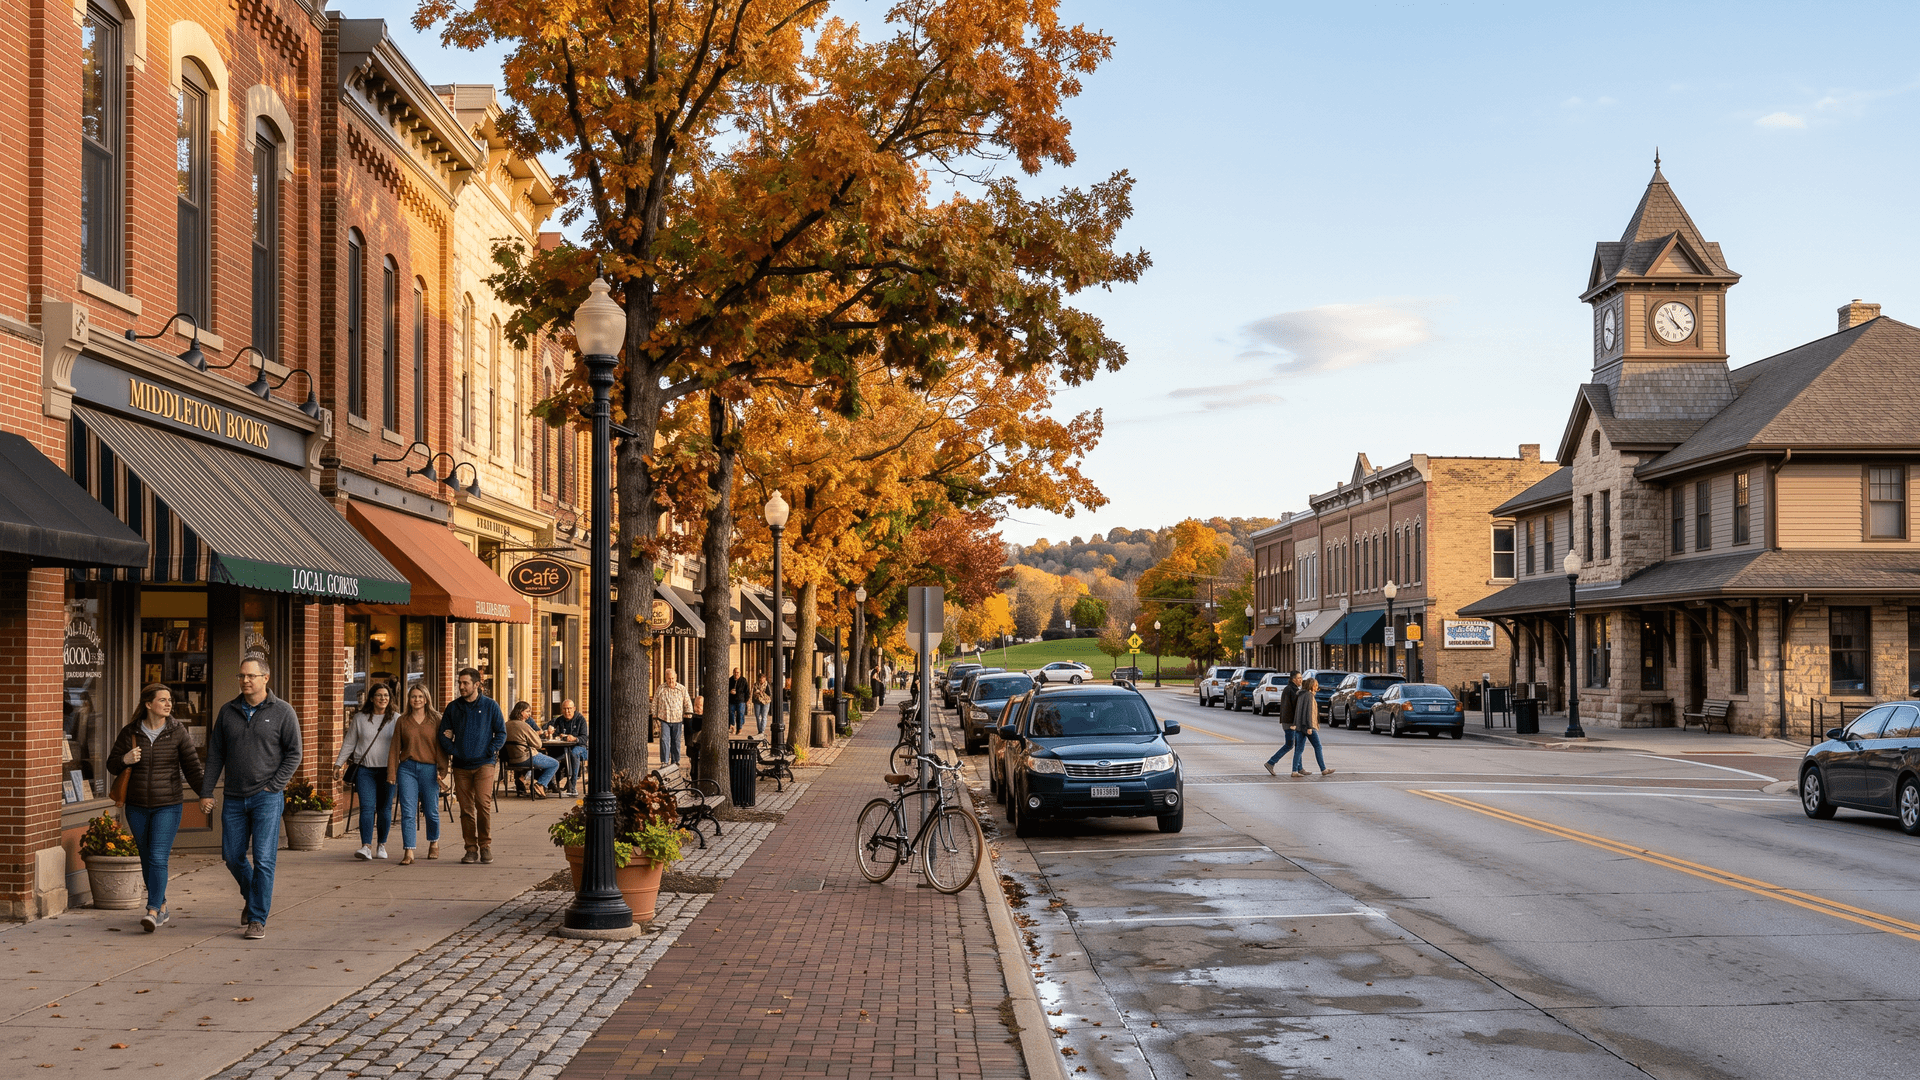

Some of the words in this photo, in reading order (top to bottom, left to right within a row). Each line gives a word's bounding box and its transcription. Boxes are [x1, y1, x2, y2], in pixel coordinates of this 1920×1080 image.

[129, 378, 222, 435] MIDDLETON
[225, 411, 270, 450] BOOKS
[292, 568, 326, 593] LOCAL
[518, 567, 560, 587] Café
